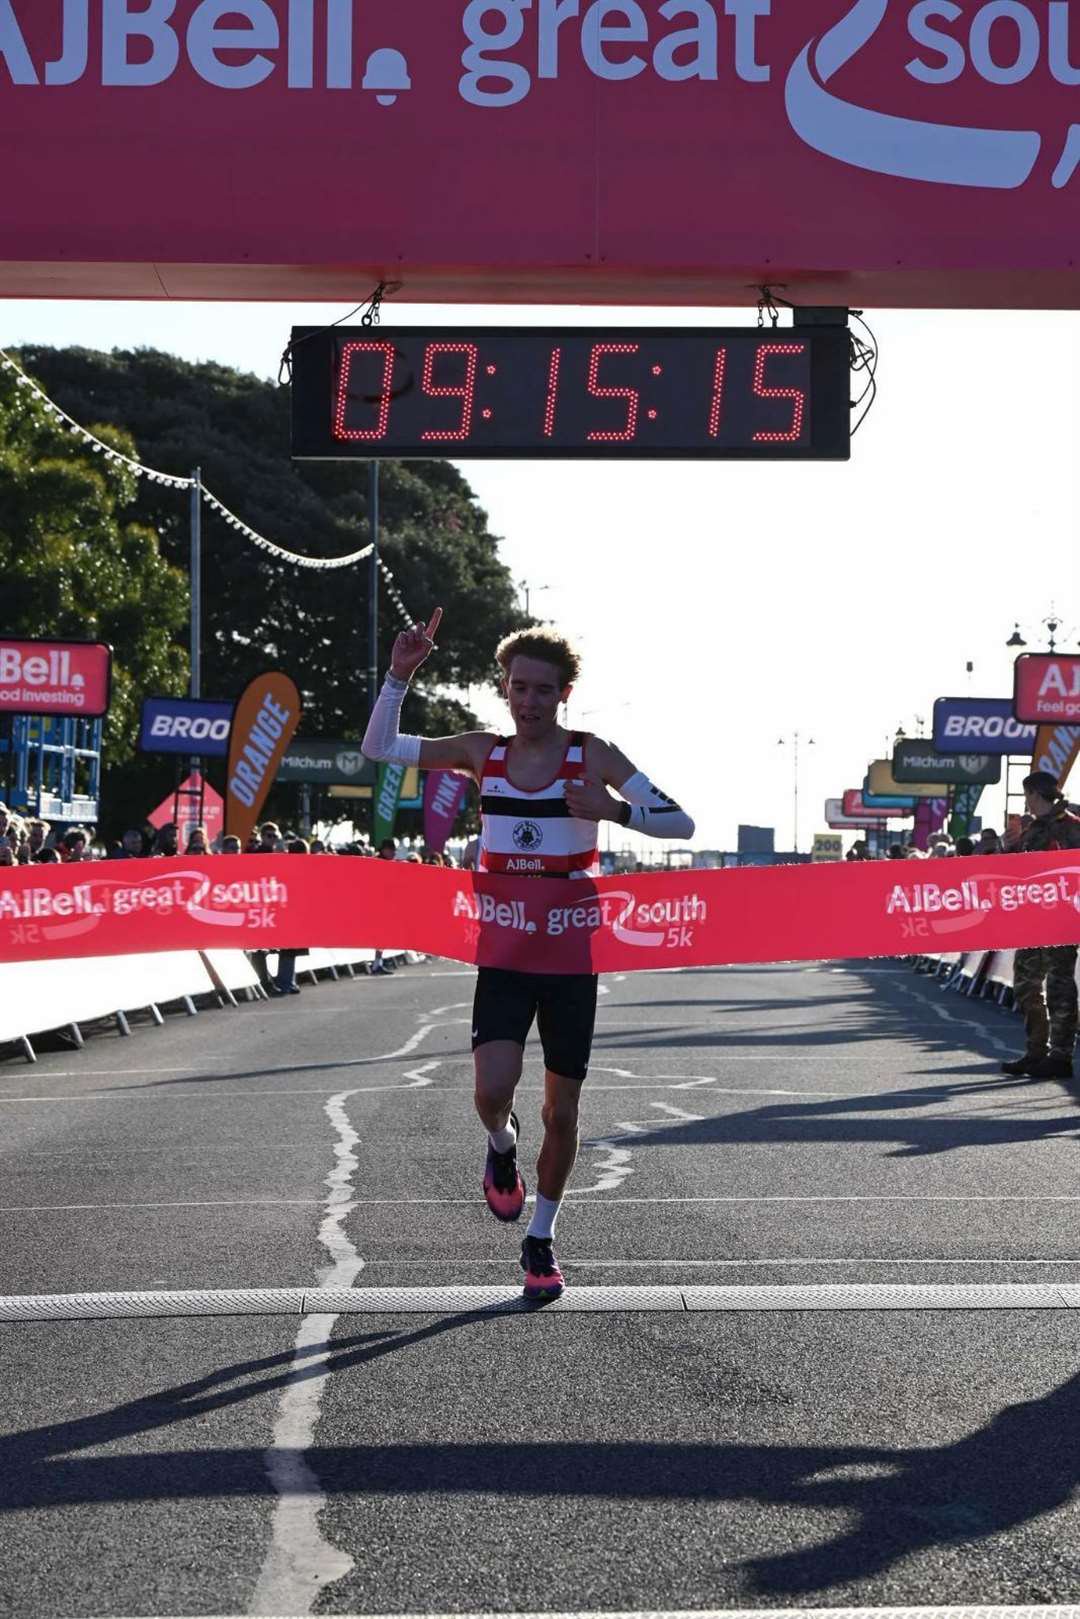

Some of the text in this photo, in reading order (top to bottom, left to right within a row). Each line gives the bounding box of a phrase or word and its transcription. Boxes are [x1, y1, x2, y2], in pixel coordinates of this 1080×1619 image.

[458, 0, 770, 107] great
[332, 342, 804, 441] 09:15:15
[22, 689, 85, 707] investing
[150, 715, 231, 740] BROO
[229, 693, 290, 808] ORANGE
[281, 756, 332, 769] Mitchum
[903, 755, 955, 768] Mitchum
[432, 774, 460, 818] PINK
[113, 880, 185, 915] great
[212, 877, 288, 904] south
[1000, 876, 1071, 911] great
[247, 909, 276, 928] 5k
[547, 901, 612, 935] great
[637, 894, 706, 923] south
[667, 927, 693, 948] 5k
